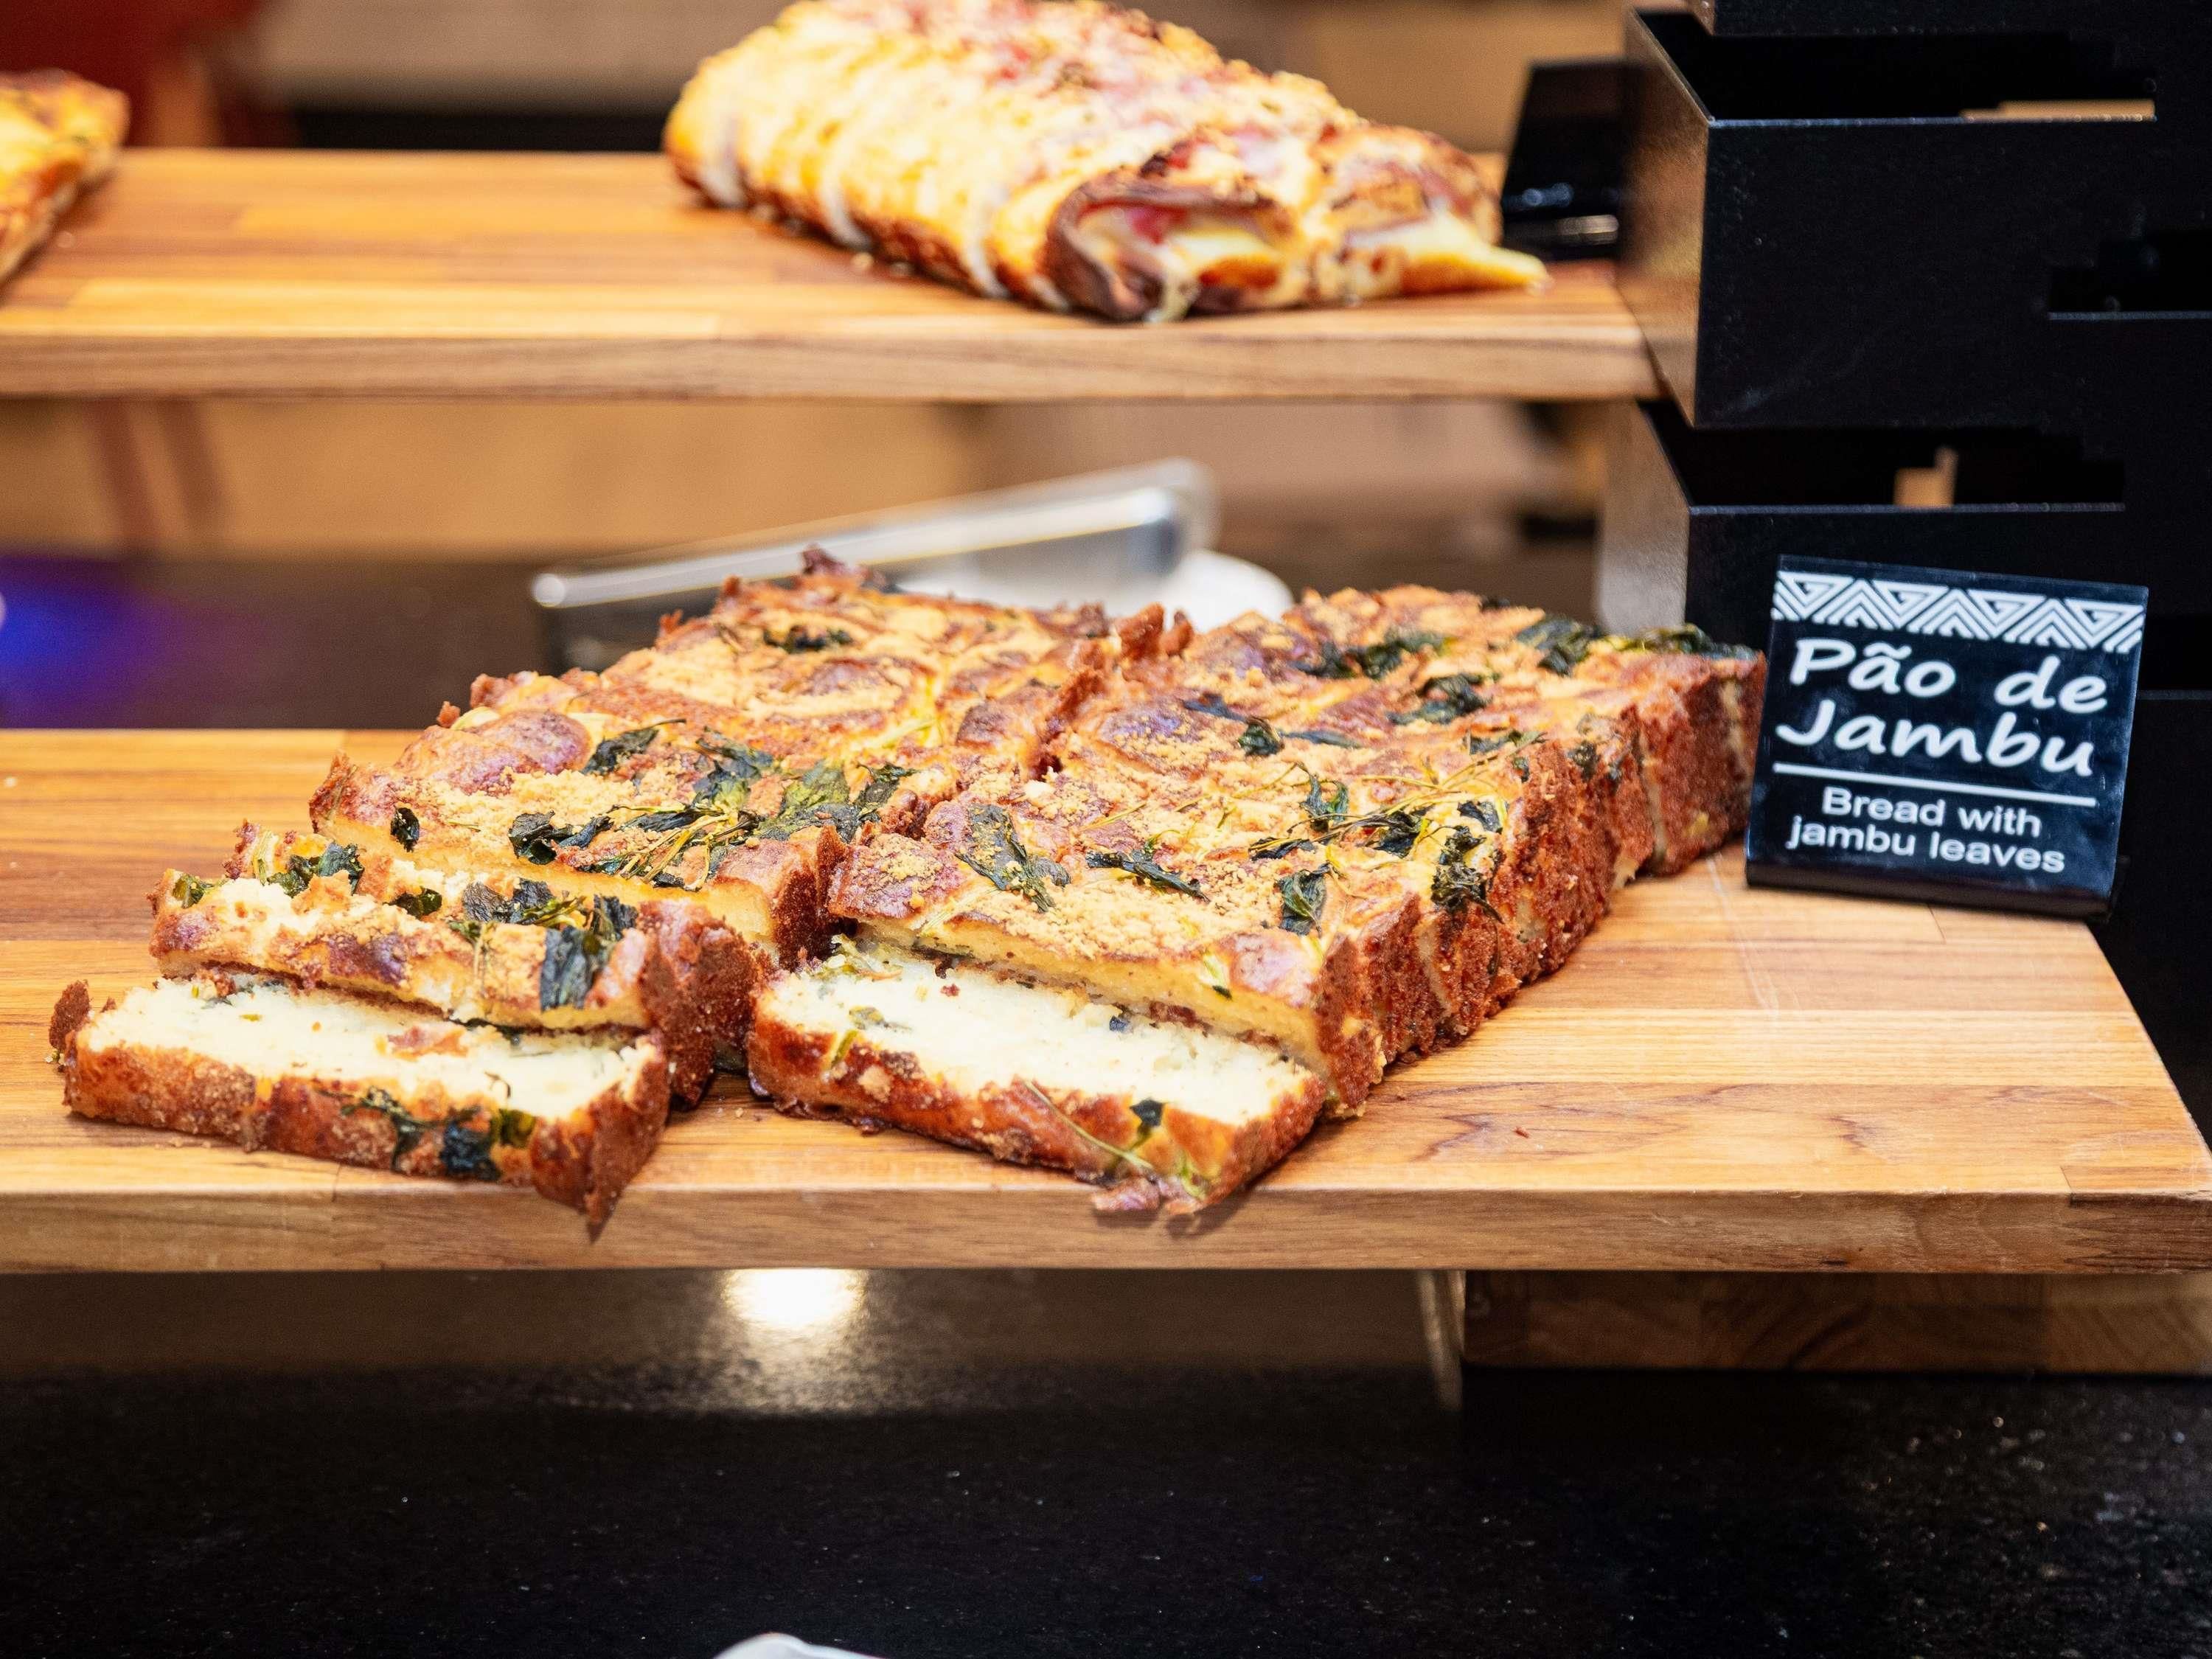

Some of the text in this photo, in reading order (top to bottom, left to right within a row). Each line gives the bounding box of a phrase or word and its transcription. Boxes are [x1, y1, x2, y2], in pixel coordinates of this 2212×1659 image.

[1790, 638, 2108, 714] Pão de
[1775, 700, 2093, 776] Jambu
[1786, 815, 2065, 873] jambu leaves
[1822, 786, 2042, 838] Bread with
